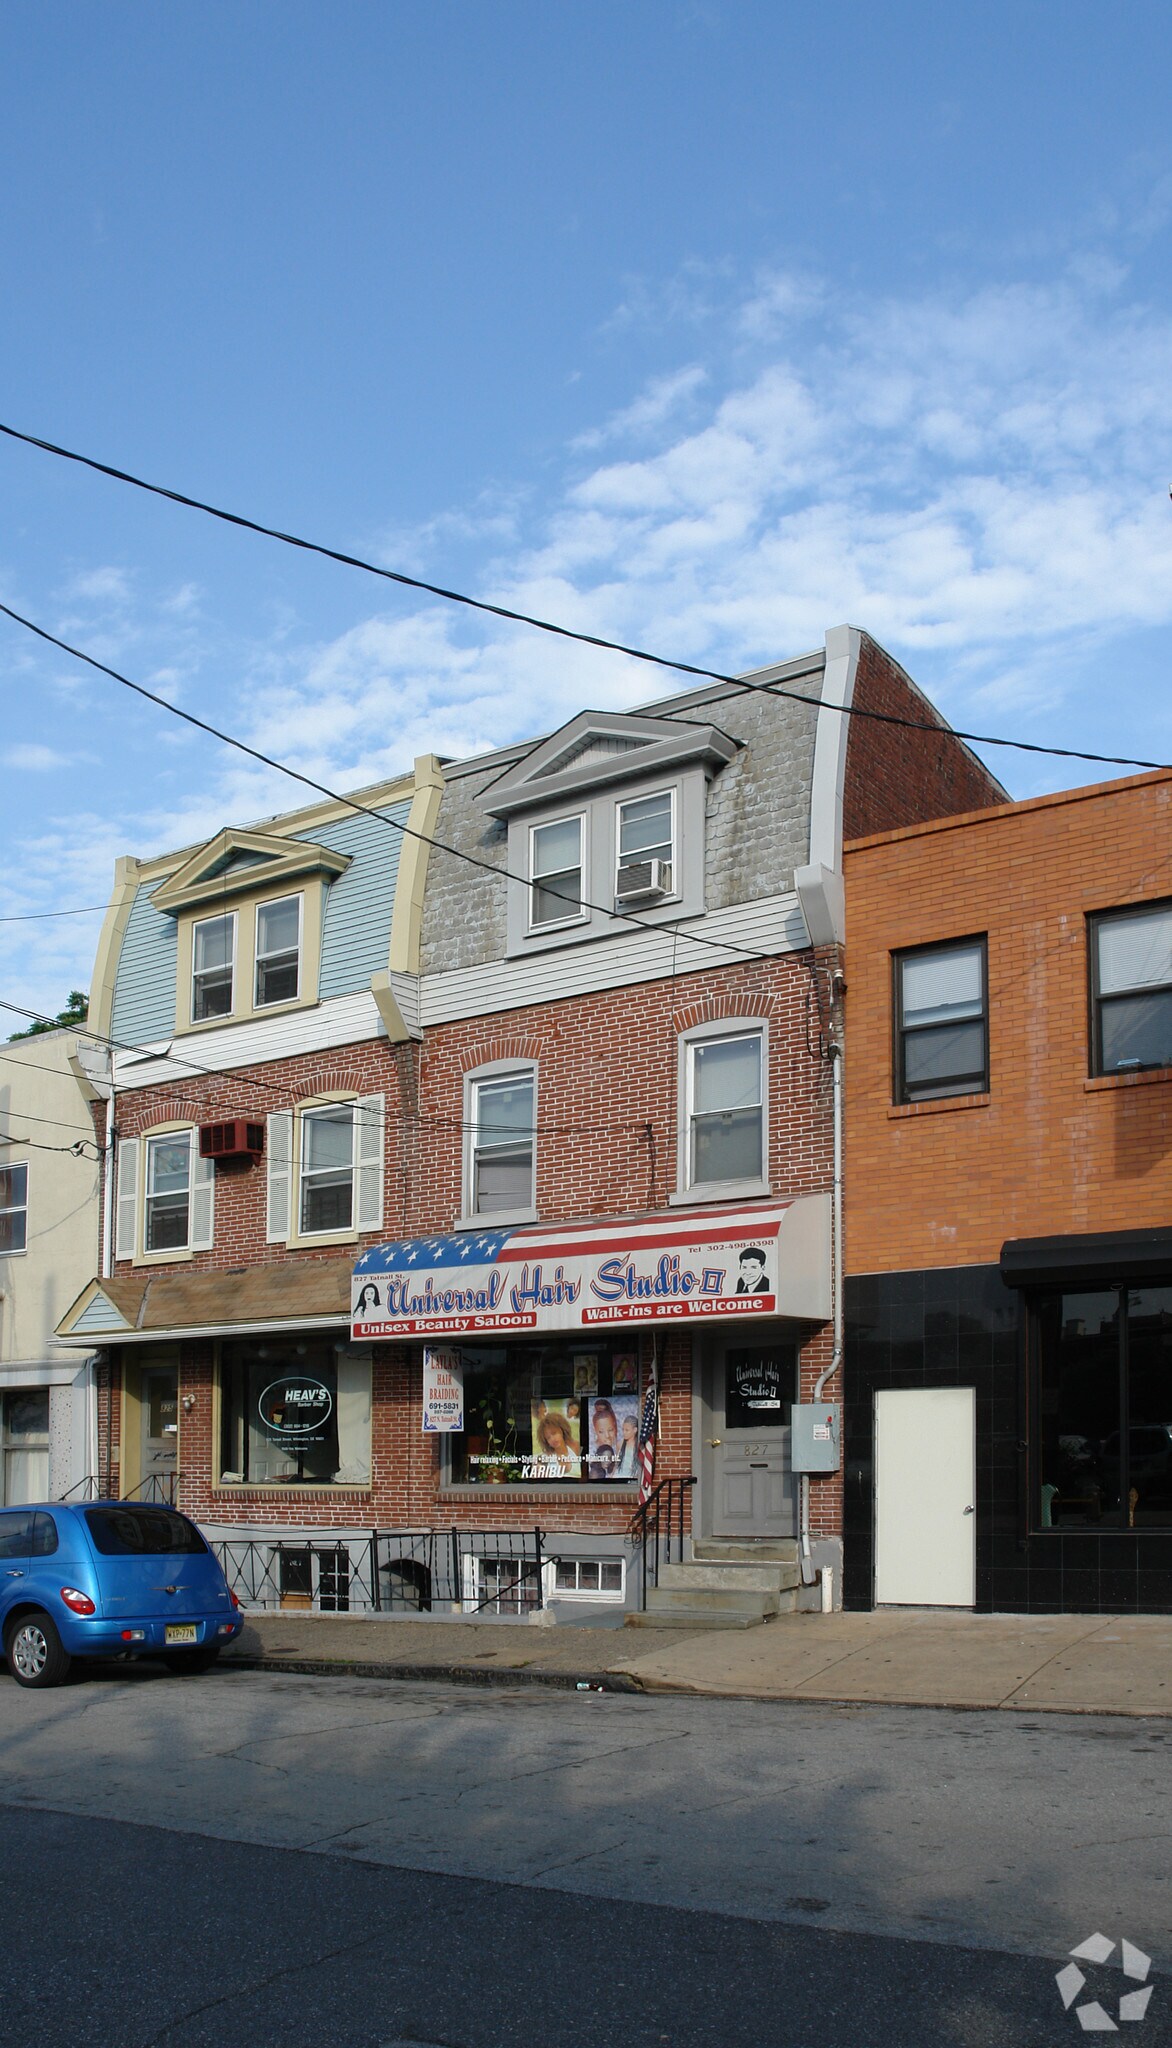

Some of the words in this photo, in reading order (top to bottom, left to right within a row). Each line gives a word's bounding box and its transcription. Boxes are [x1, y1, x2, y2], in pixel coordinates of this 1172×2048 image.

[386, 1267, 510, 1317] Universal
[510, 1262, 582, 1314] Hair
[589, 1252, 700, 1302] Studio
[586, 1304, 652, 1321] Walk-ins
[656, 1304, 683, 1316] are
[688, 1297, 764, 1314] Welcome
[360, 1321, 410, 1335] Unisex
[415, 1317, 470, 1331] Beauty
[474, 1312, 533, 1328] Saloon
[736, 1360, 763, 1382] Universal
[437, 1374, 452, 1386] HAIR
[285, 1389, 327, 1401] HEAV'S
[429, 1388, 459, 1400] BRAIDING
[739, 1383, 770, 1397] Studio
[429, 1402, 459, 1410] 691-5831
[744, 1444, 768, 1456] 827
[521, 1465, 566, 1479] KARIBU
